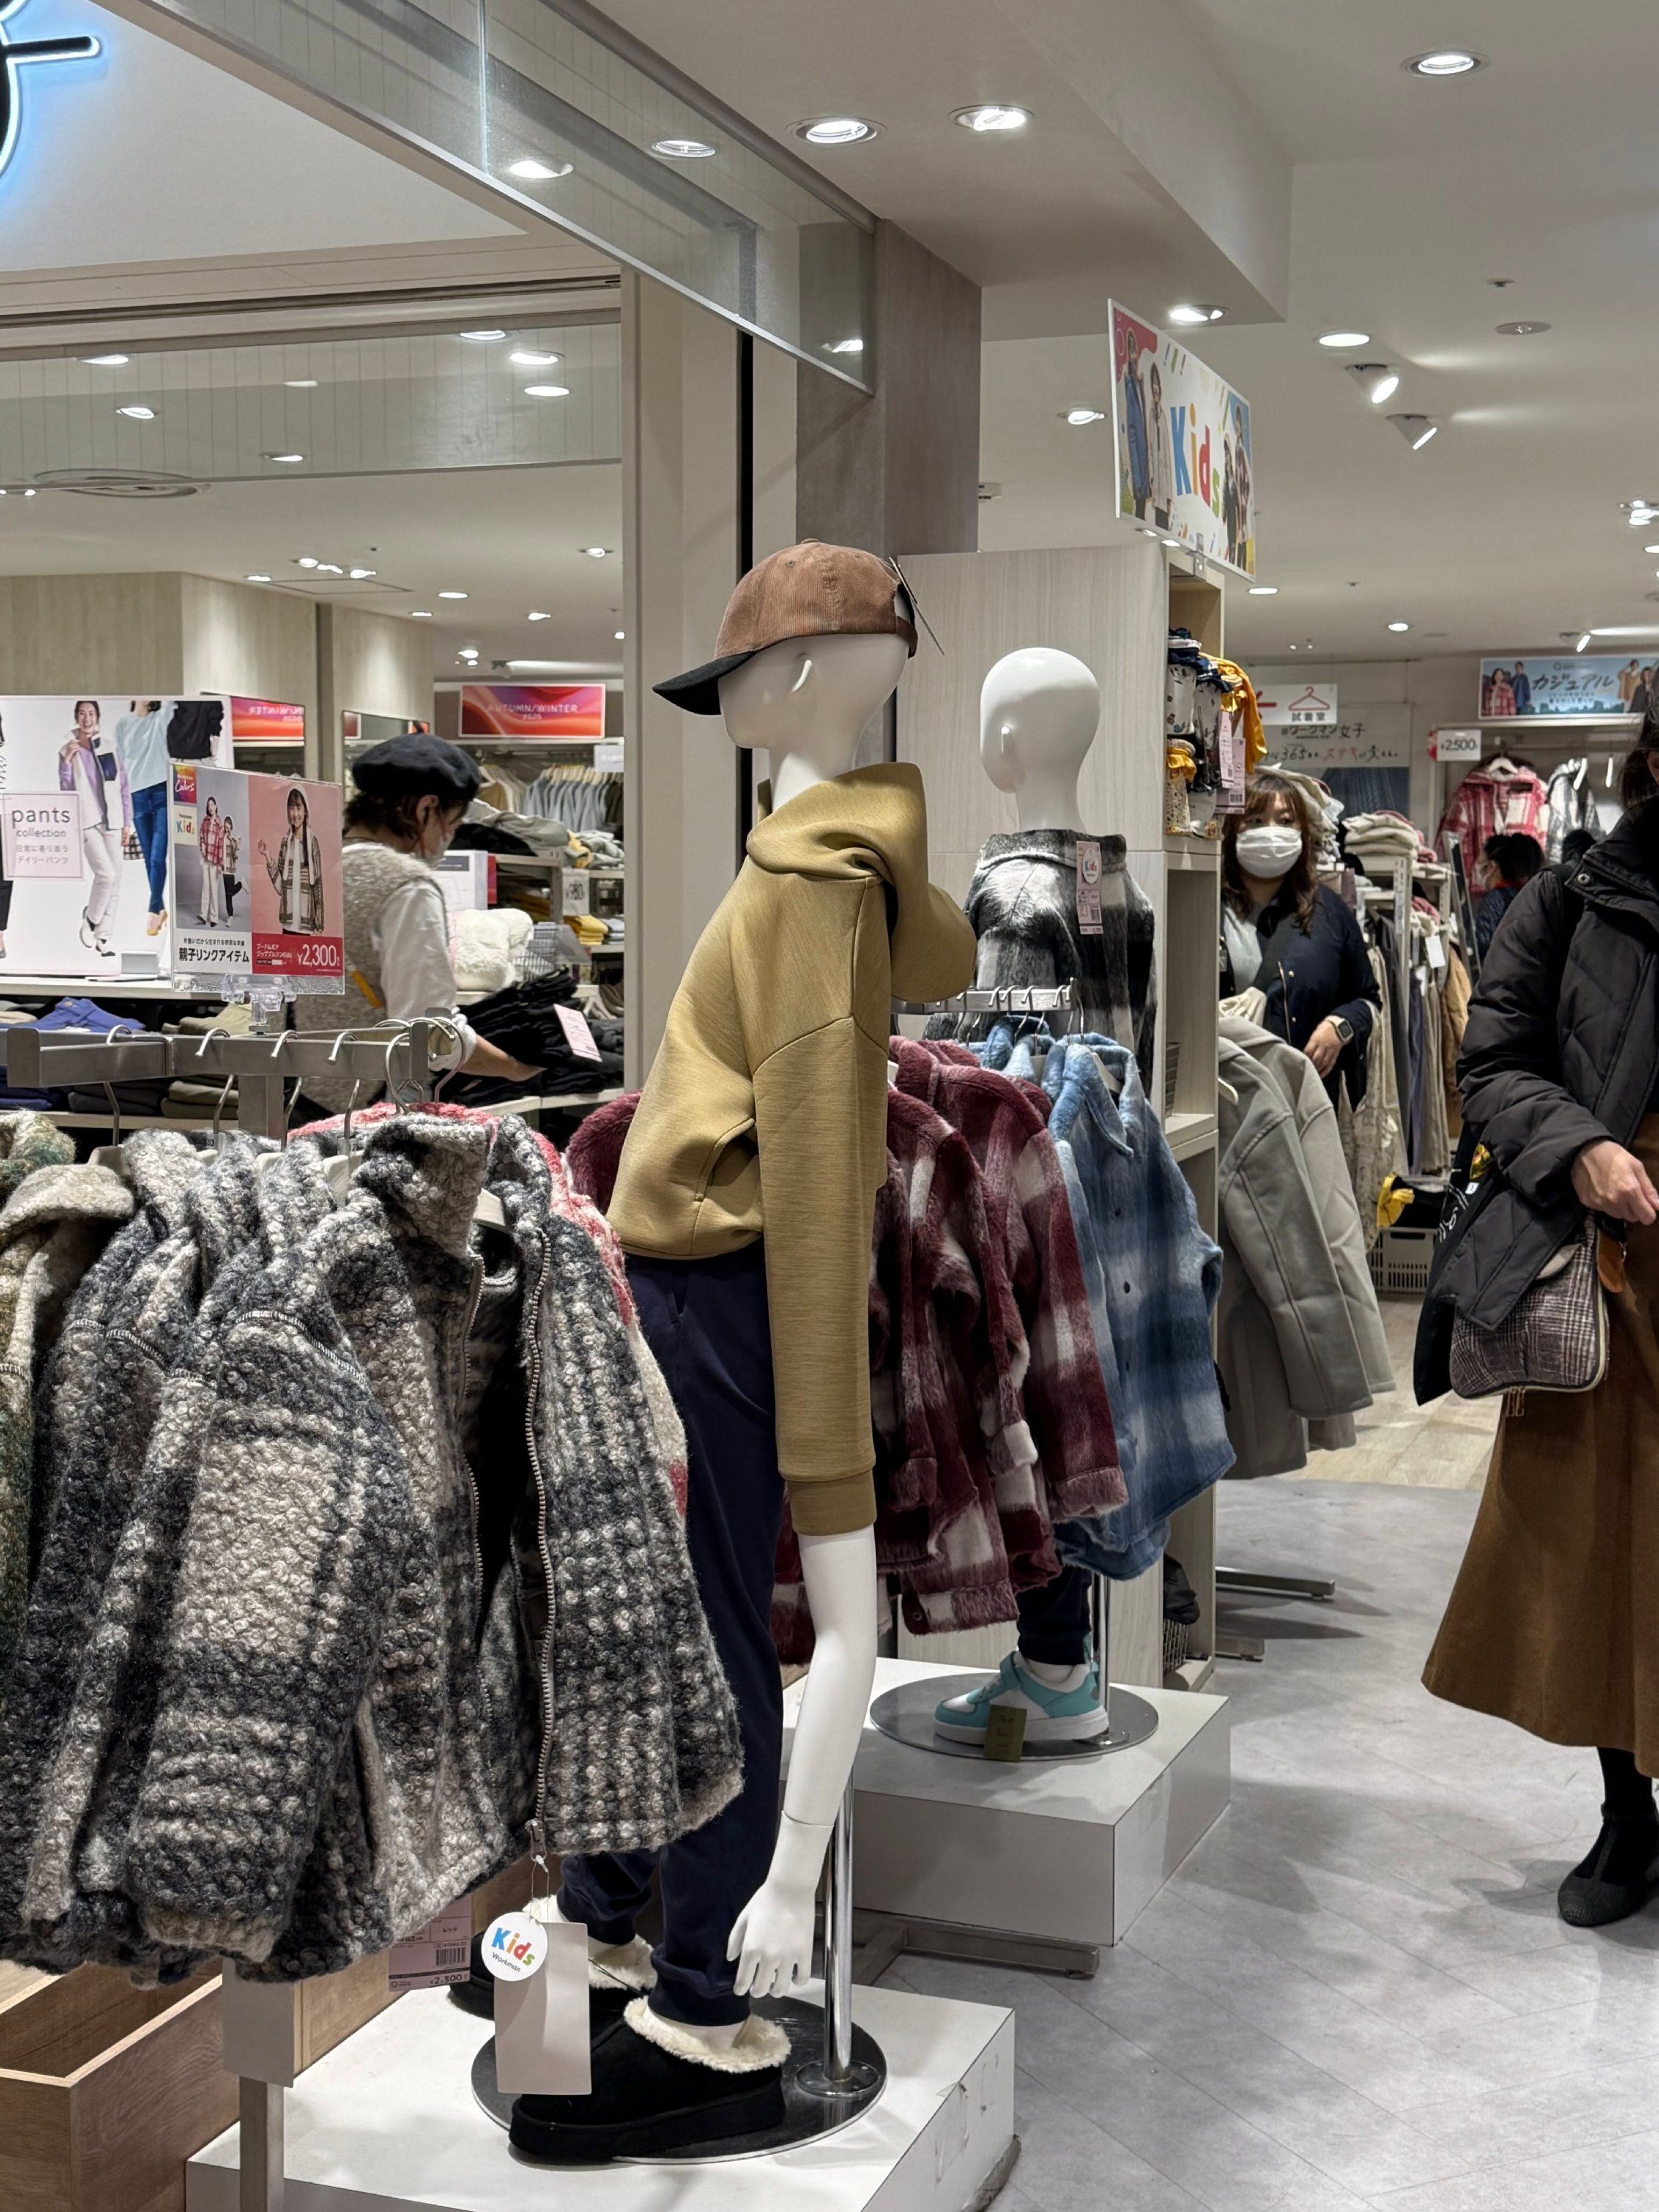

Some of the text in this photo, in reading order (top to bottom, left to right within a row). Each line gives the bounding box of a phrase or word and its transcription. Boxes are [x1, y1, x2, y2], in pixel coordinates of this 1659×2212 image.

[1169, 402, 1220, 518] Kids
[1531, 672, 1614, 691] カジュアル
[487, 704, 578, 713] AUTUMN/WINTER
[1292, 712, 1326, 722] 試着室
[12, 807, 71, 829] pants
[16, 828, 66, 838] collection
[18, 855, 69, 863] デイリーパンツ
[179, 947, 250, 962] 親子リンクアイテム
[491, 1927, 535, 1966] Kids
[492, 1952, 521, 1972] Workman
